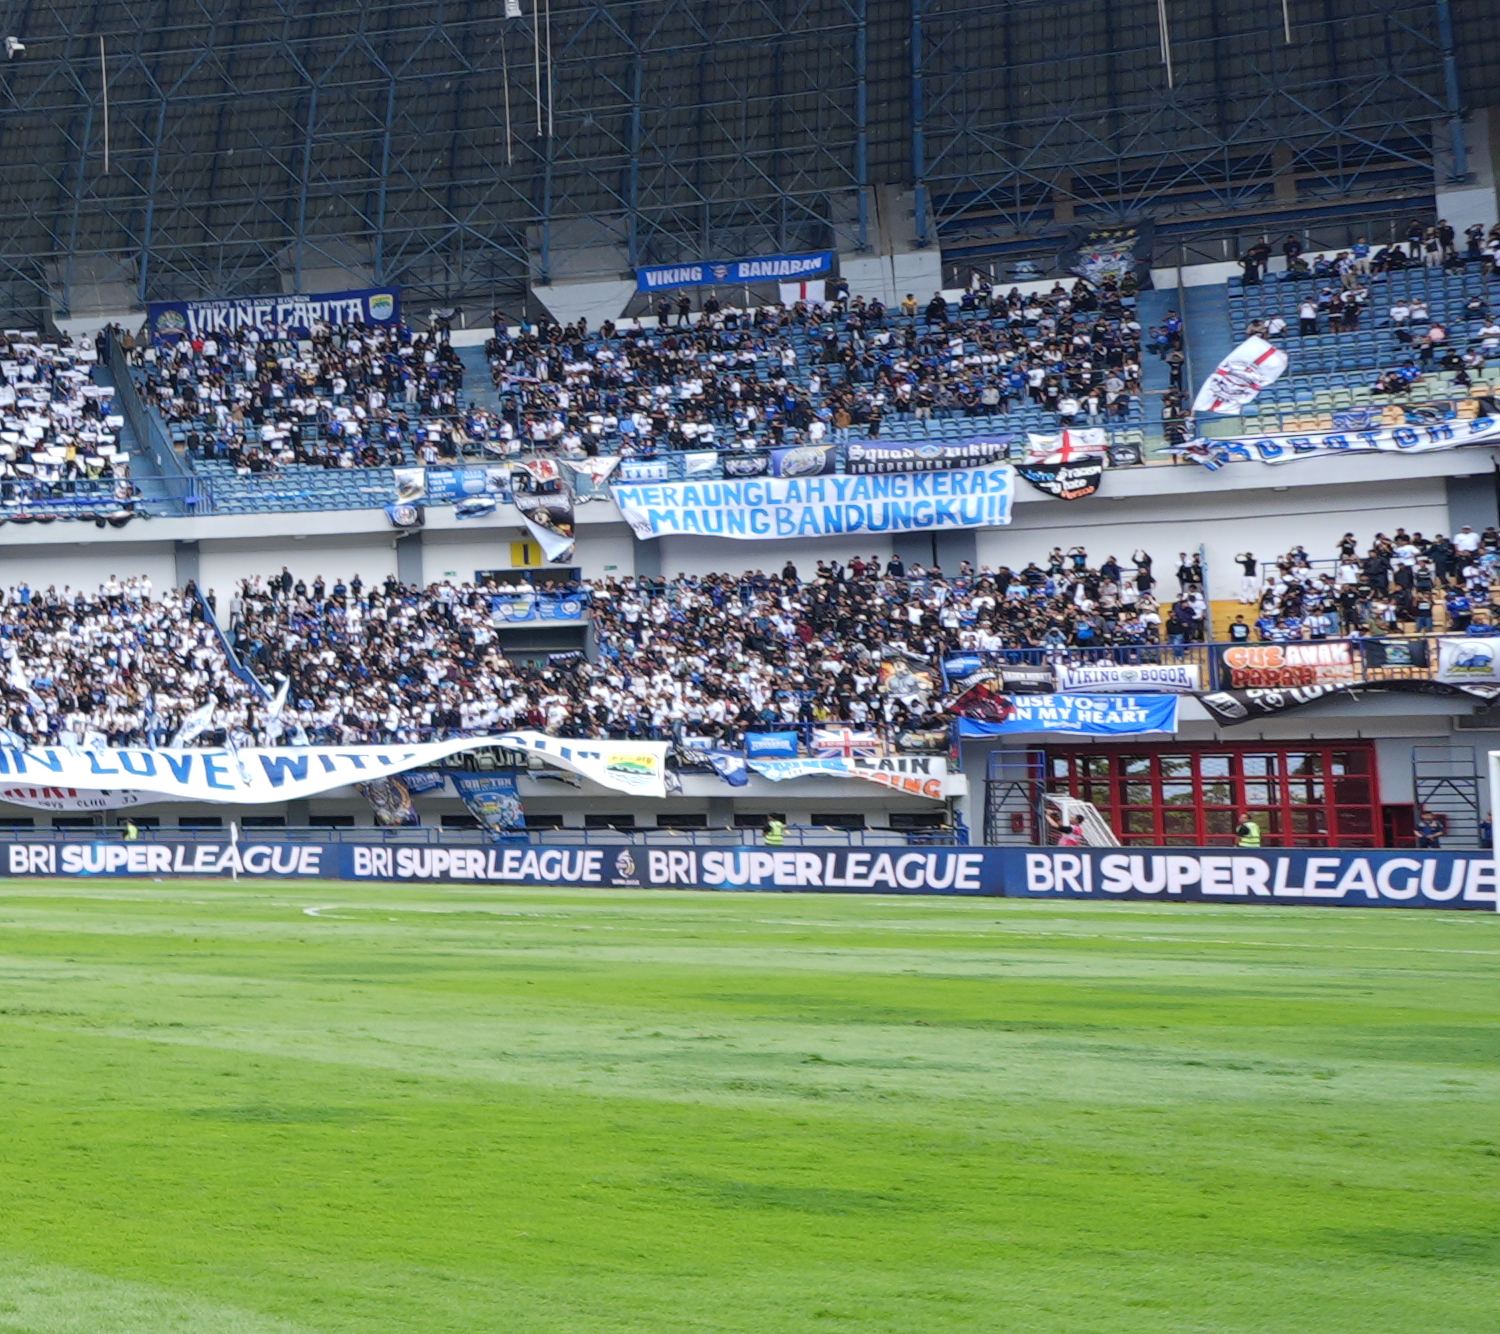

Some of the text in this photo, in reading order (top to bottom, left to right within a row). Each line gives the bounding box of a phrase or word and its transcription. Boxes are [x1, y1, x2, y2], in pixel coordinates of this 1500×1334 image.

[646, 267, 702, 285] VIKING
[187, 306, 272, 339] VIKING
[832, 475, 907, 501] YANG
[912, 469, 1007, 497] KERAS
[648, 507, 770, 535] MAUNG
[1285, 643, 1351, 666] ANAK
[1067, 669, 1119, 685] VIKING
[1141, 668, 1188, 685] BOGOR
[1043, 709, 1150, 724] MY HEART
[84, 749, 237, 790] LOVE
[9, 845, 56, 873] BRI
[354, 847, 393, 877] BRI
[648, 850, 697, 884] BRI
[1026, 853, 1093, 893] BRI
